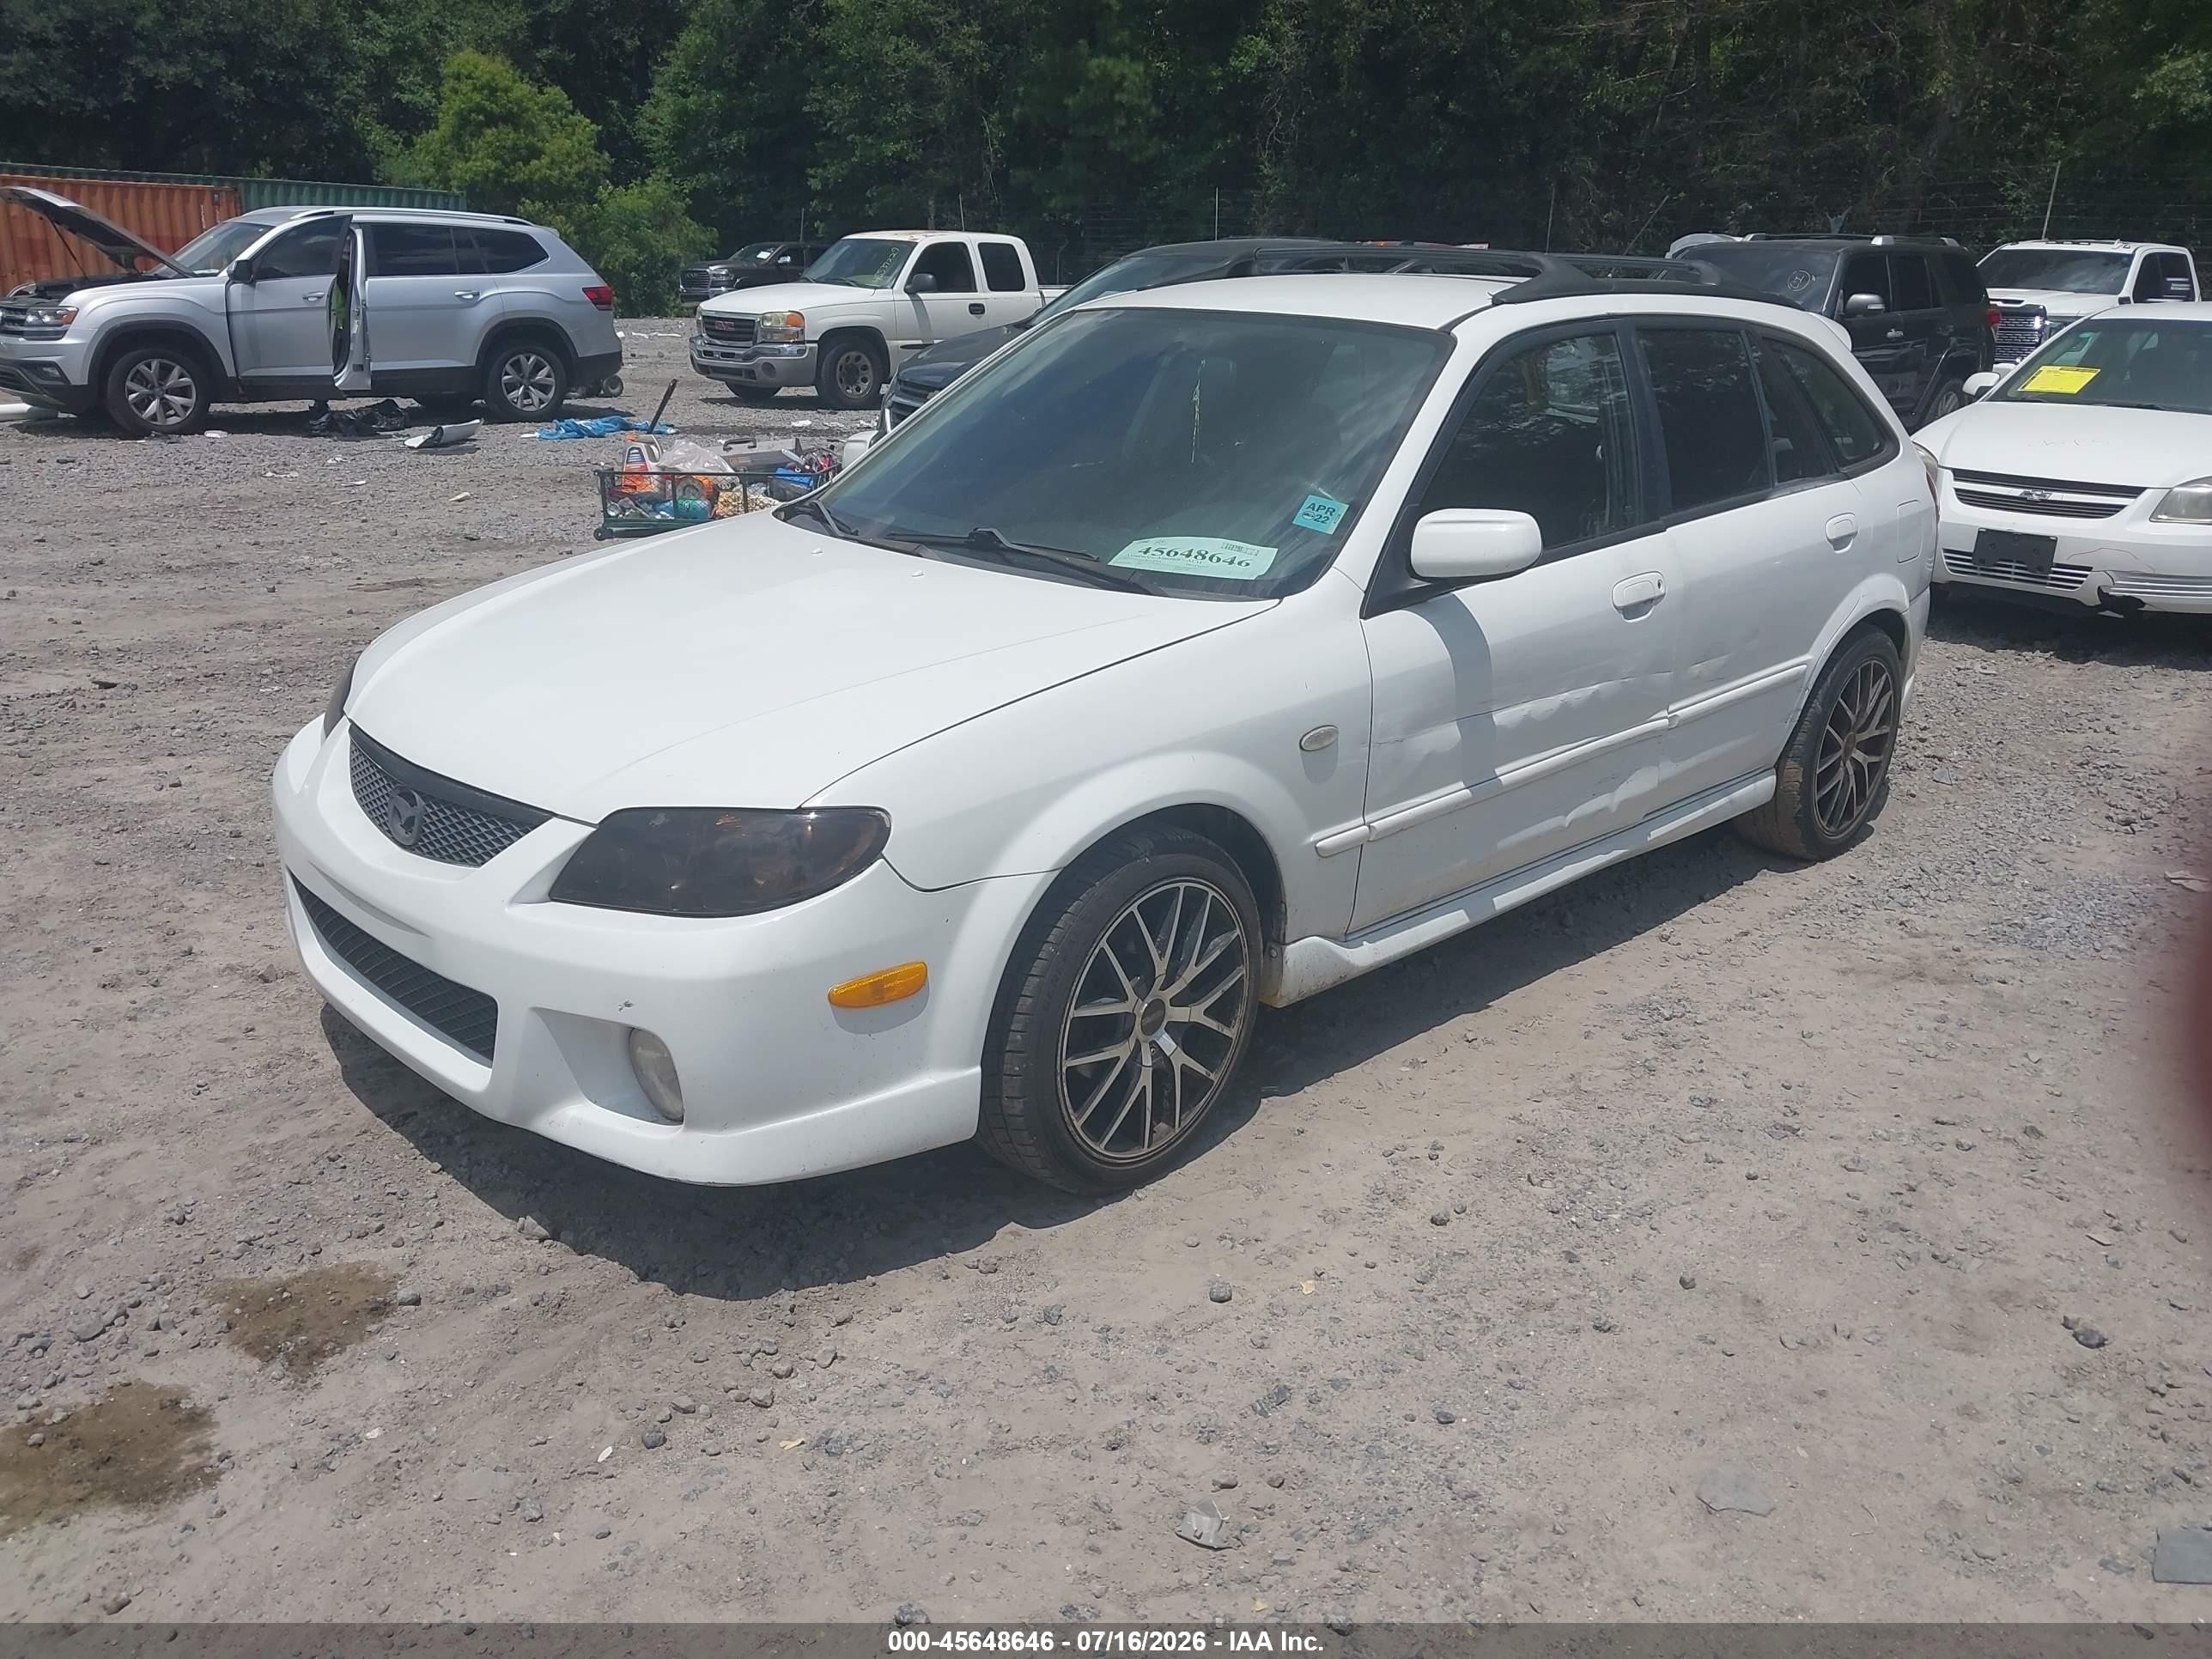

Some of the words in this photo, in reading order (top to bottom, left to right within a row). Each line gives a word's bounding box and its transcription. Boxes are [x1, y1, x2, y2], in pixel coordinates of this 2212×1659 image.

[1305, 502, 1336, 516] APR
[1314, 514, 1330, 524] 22
[1138, 546, 1251, 568] 45648646
